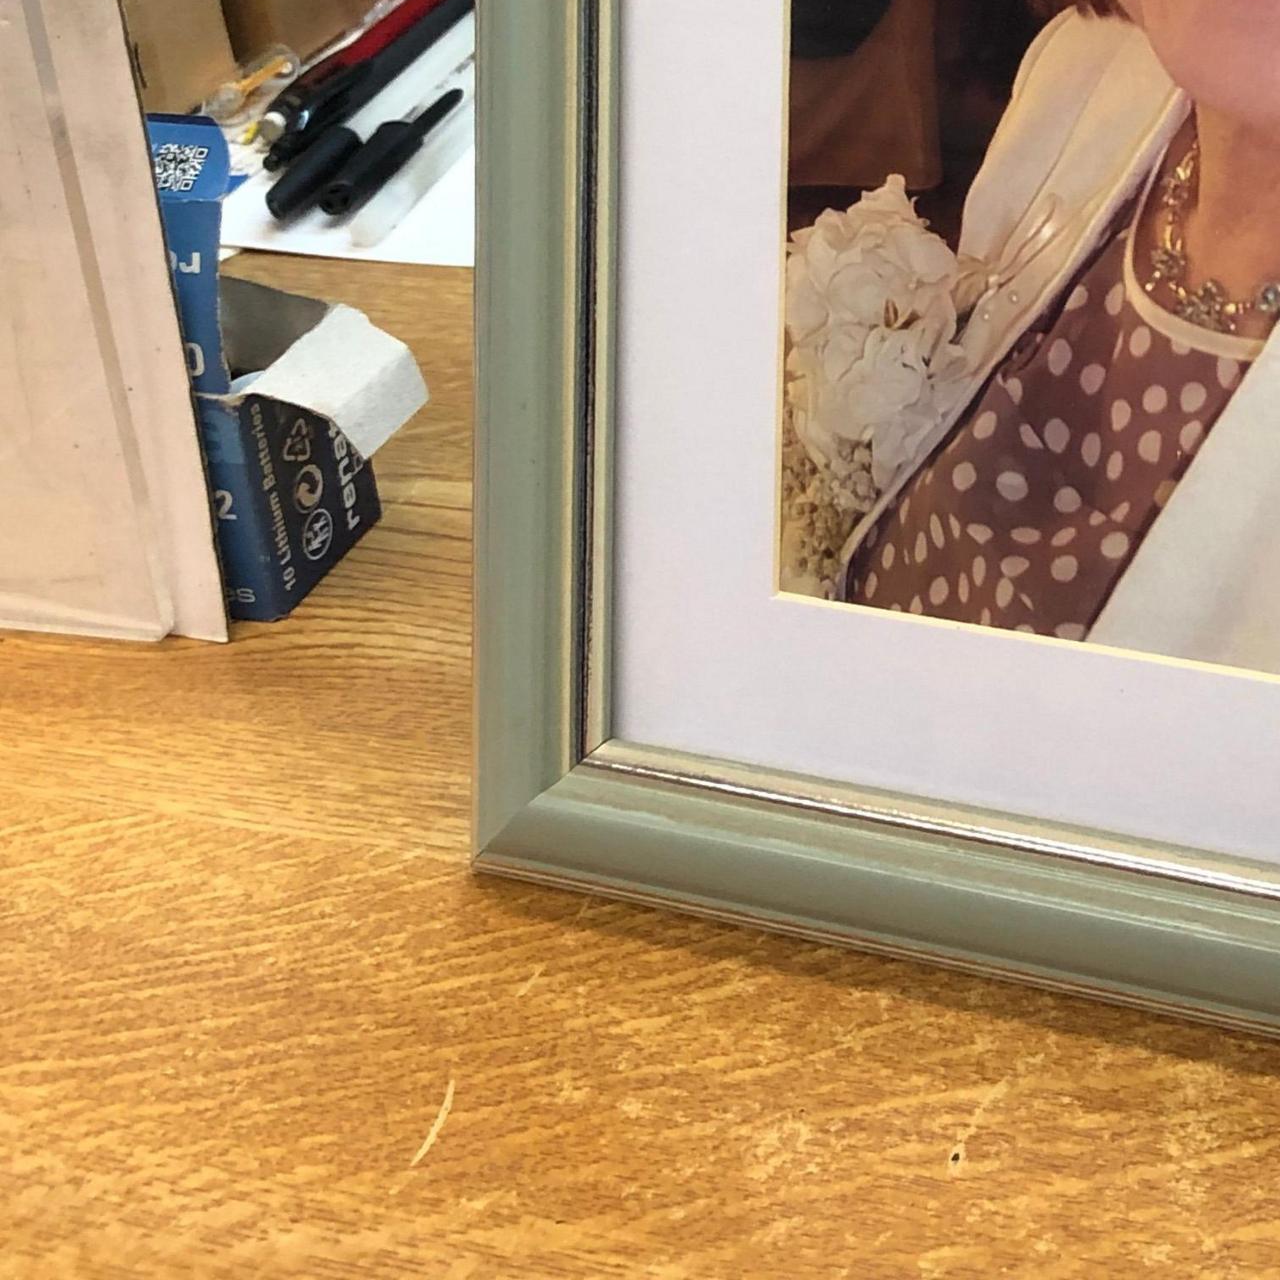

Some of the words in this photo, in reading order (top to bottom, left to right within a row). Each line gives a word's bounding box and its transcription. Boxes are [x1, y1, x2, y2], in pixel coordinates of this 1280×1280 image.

[251, 403, 277, 491] Batteries
[269, 491, 292, 565] Lithium
[282, 566, 297, 591] 10
